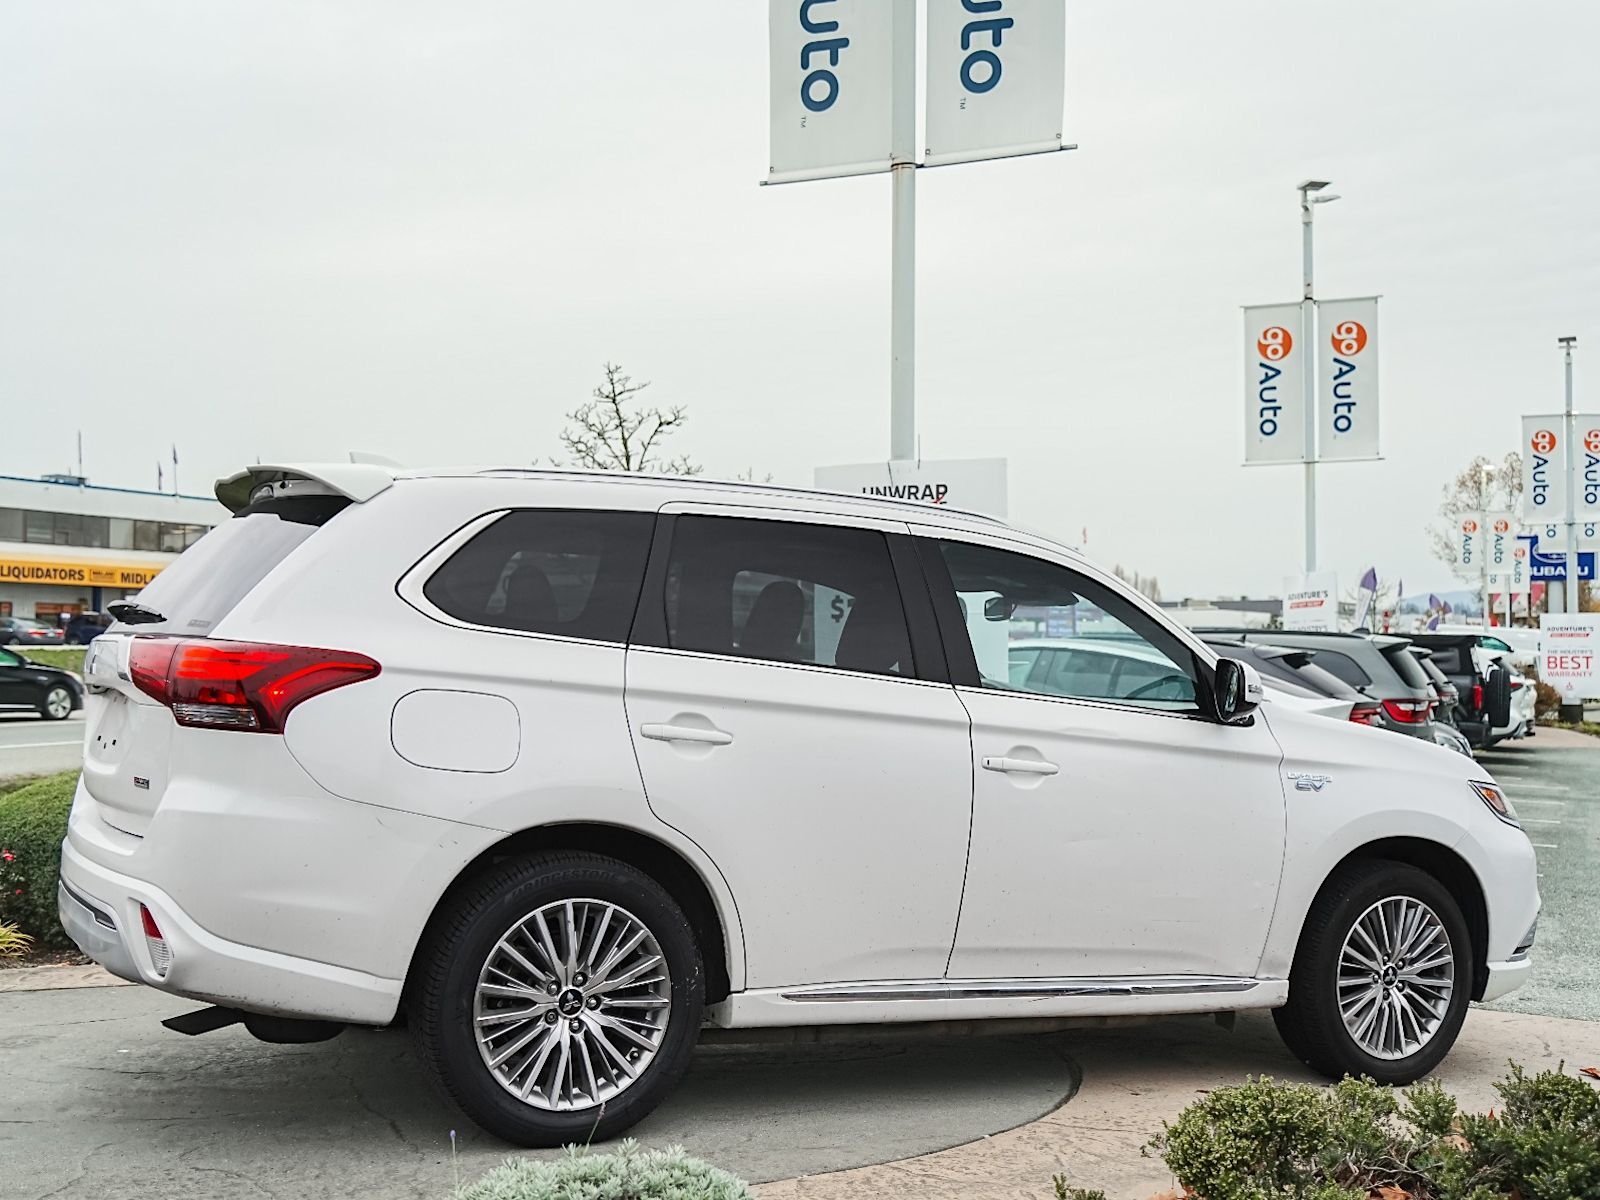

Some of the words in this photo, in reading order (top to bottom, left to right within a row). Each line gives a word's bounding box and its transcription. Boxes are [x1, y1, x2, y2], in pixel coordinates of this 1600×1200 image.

[1259, 362, 1282, 436] Auto
[1333, 357, 1356, 432] Auto
[1533, 454, 1549, 505] Auto
[1585, 453, 1600, 504] Auto
[1463, 534, 1472, 564] Auto
[1494, 534, 1504, 564] Auto
[0, 565, 85, 581] LIQUIDATORS
[1530, 566, 1589, 577] UBAU
[1547, 656, 1593, 669] BEST
[1295, 780, 1325, 792] EV
